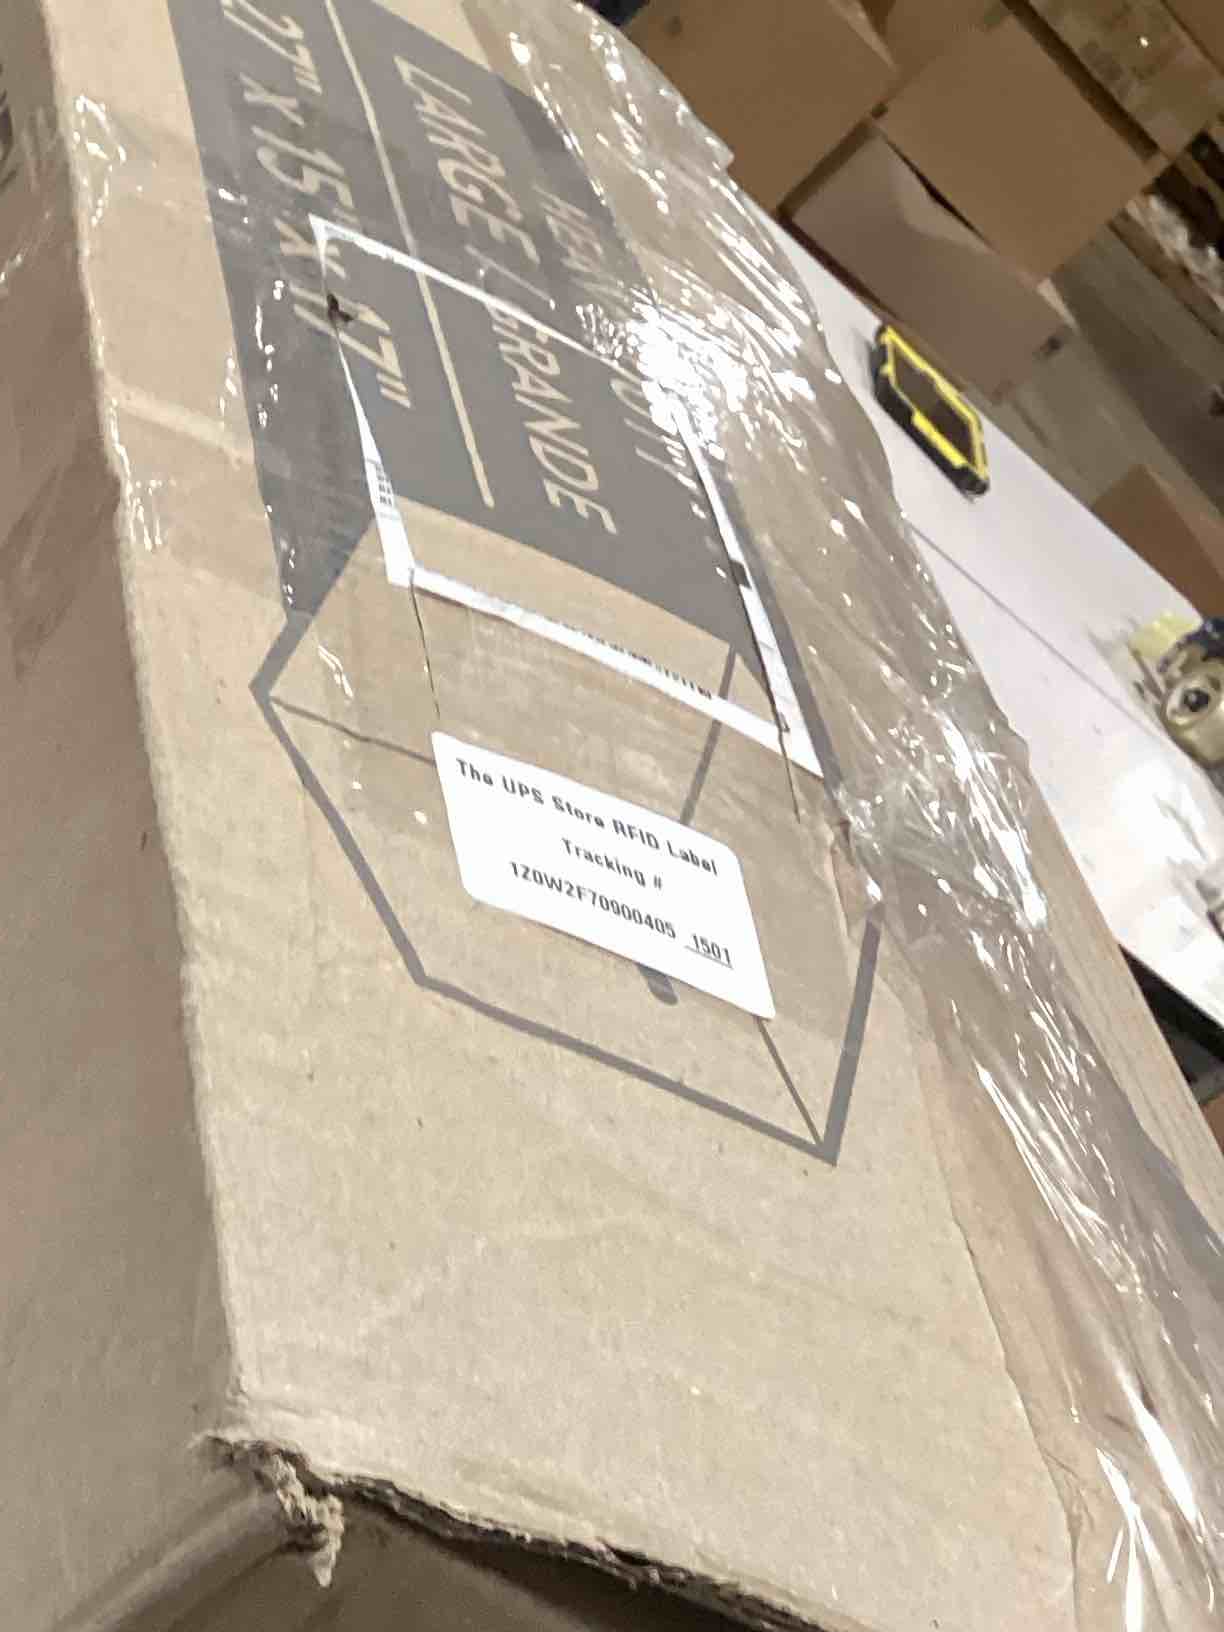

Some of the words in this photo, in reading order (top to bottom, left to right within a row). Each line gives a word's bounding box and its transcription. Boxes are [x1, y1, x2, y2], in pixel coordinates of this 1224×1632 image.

[393, 54, 541, 265] LARGE
[455, 757, 494, 787] The
[501, 775, 545, 805] UPS
[551, 794, 605, 829] Store
[612, 818, 660, 851] RFID
[666, 839, 718, 877] Label
[561, 836, 647, 887] Tracking
